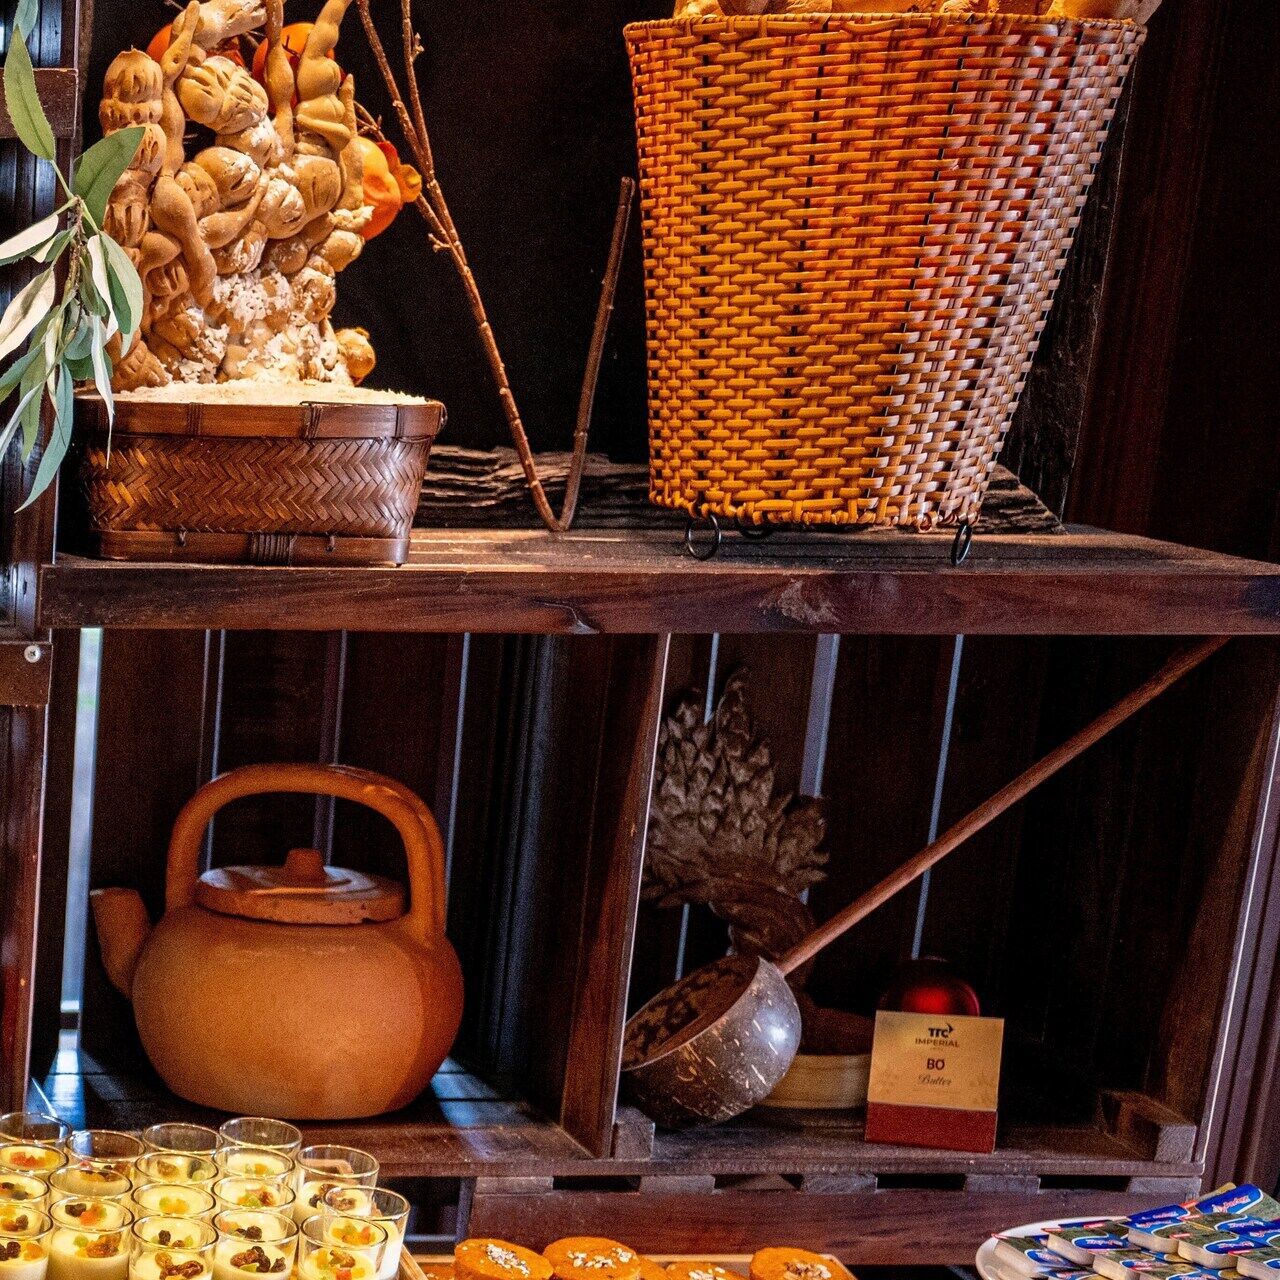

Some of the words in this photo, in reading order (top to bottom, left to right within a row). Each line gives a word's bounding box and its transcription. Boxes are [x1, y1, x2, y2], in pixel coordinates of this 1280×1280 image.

[927, 1027, 949, 1038] TTC
[915, 1038, 960, 1048] IMPERIAL
[918, 1074, 952, 1085] Butter
